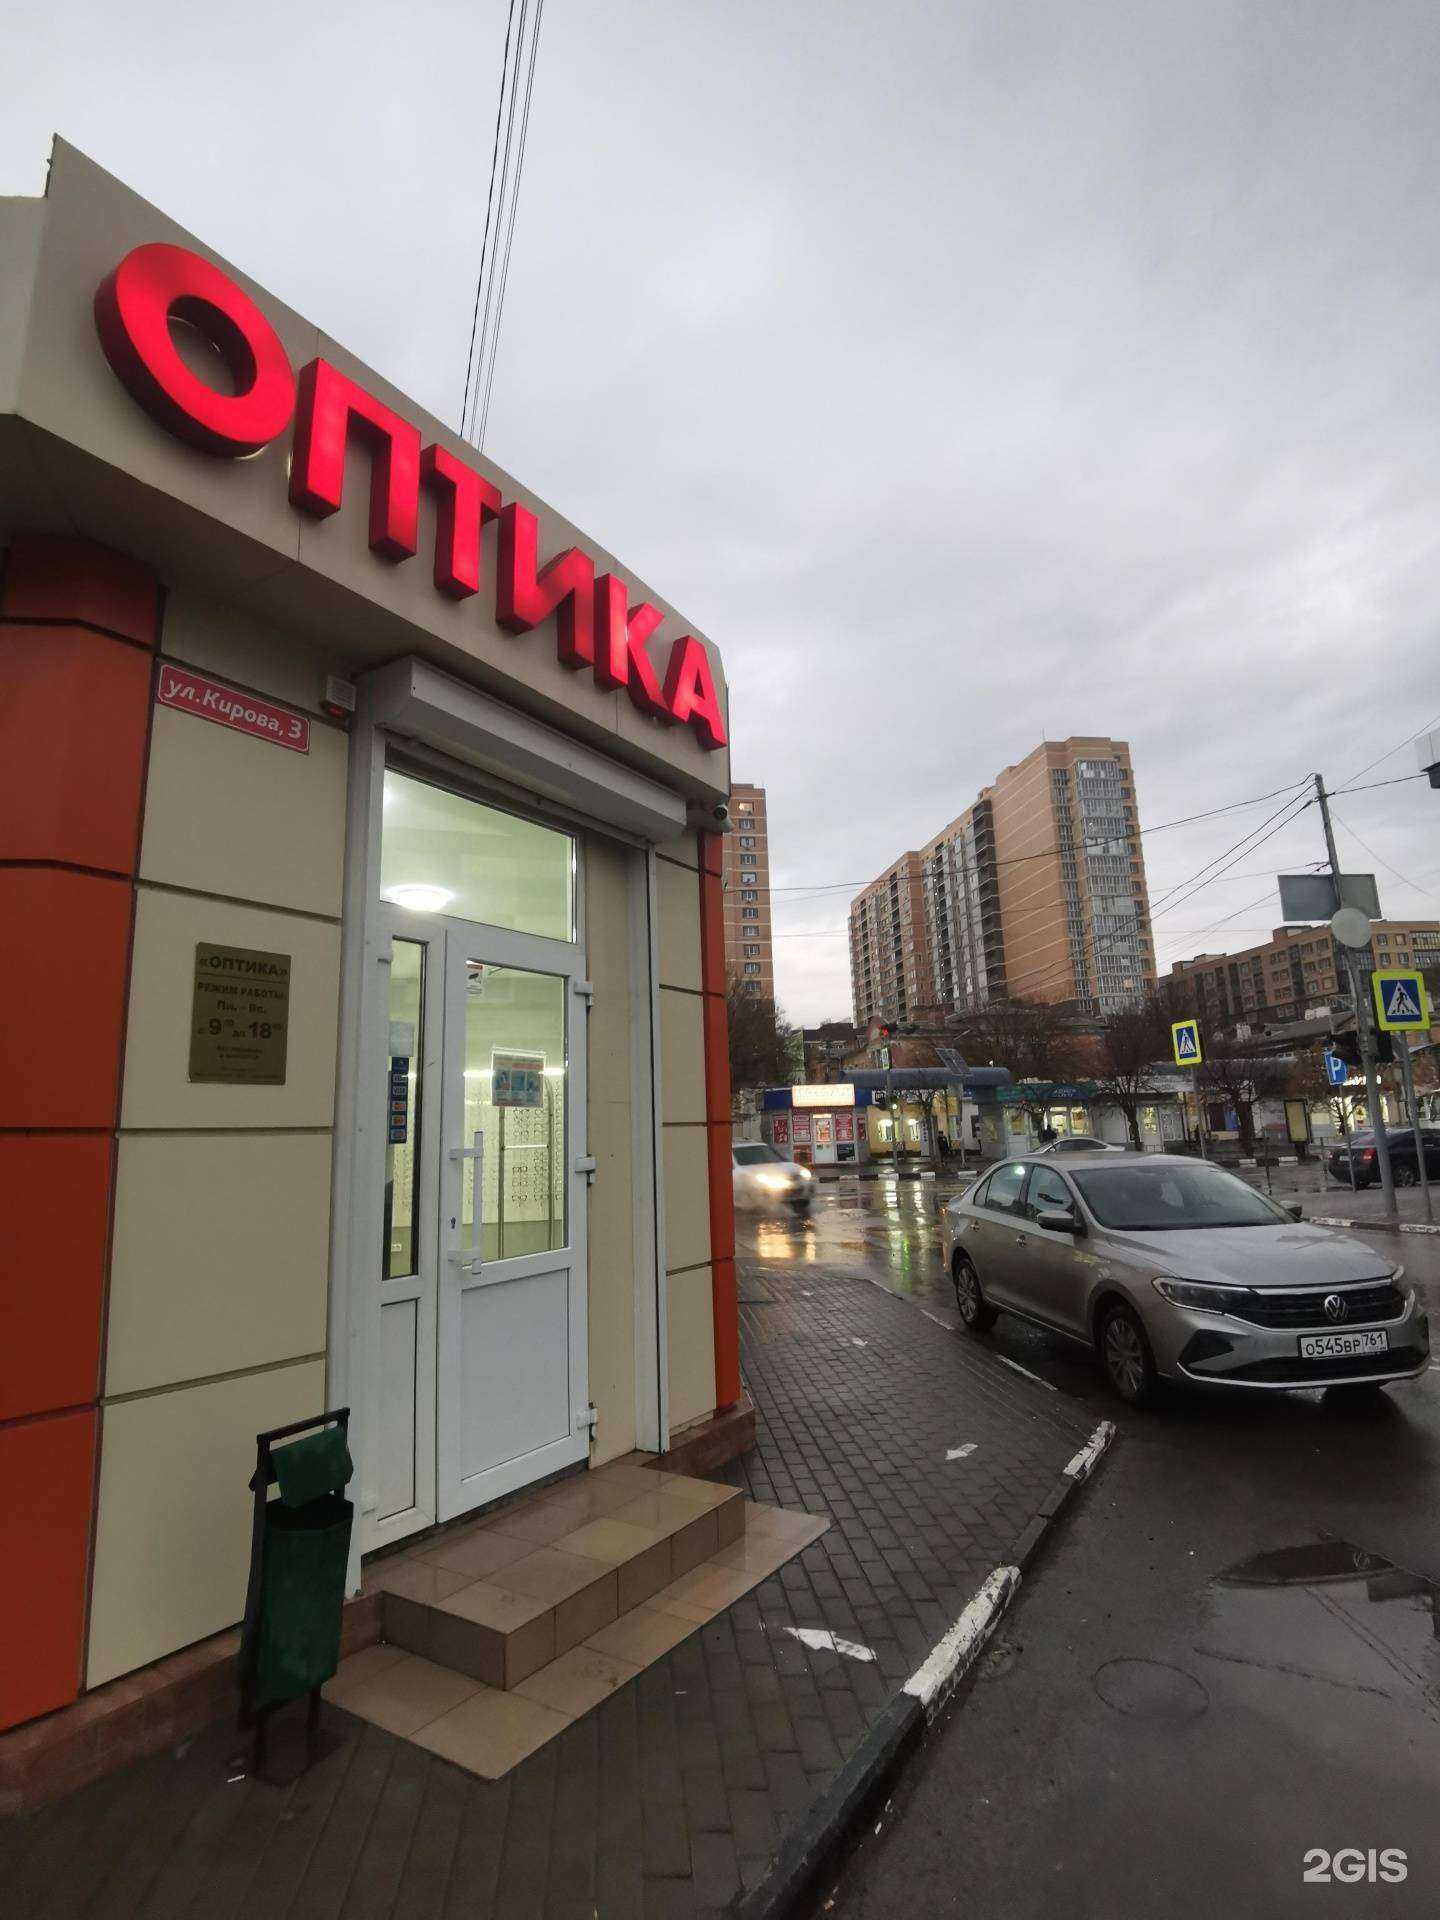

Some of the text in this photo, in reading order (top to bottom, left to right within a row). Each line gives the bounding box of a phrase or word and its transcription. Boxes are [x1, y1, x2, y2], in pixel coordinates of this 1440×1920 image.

[94, 242, 728, 751] ОПТИКА
[287, 719, 303, 739] 3
[199, 956, 289, 977] «ОПТИКА»
